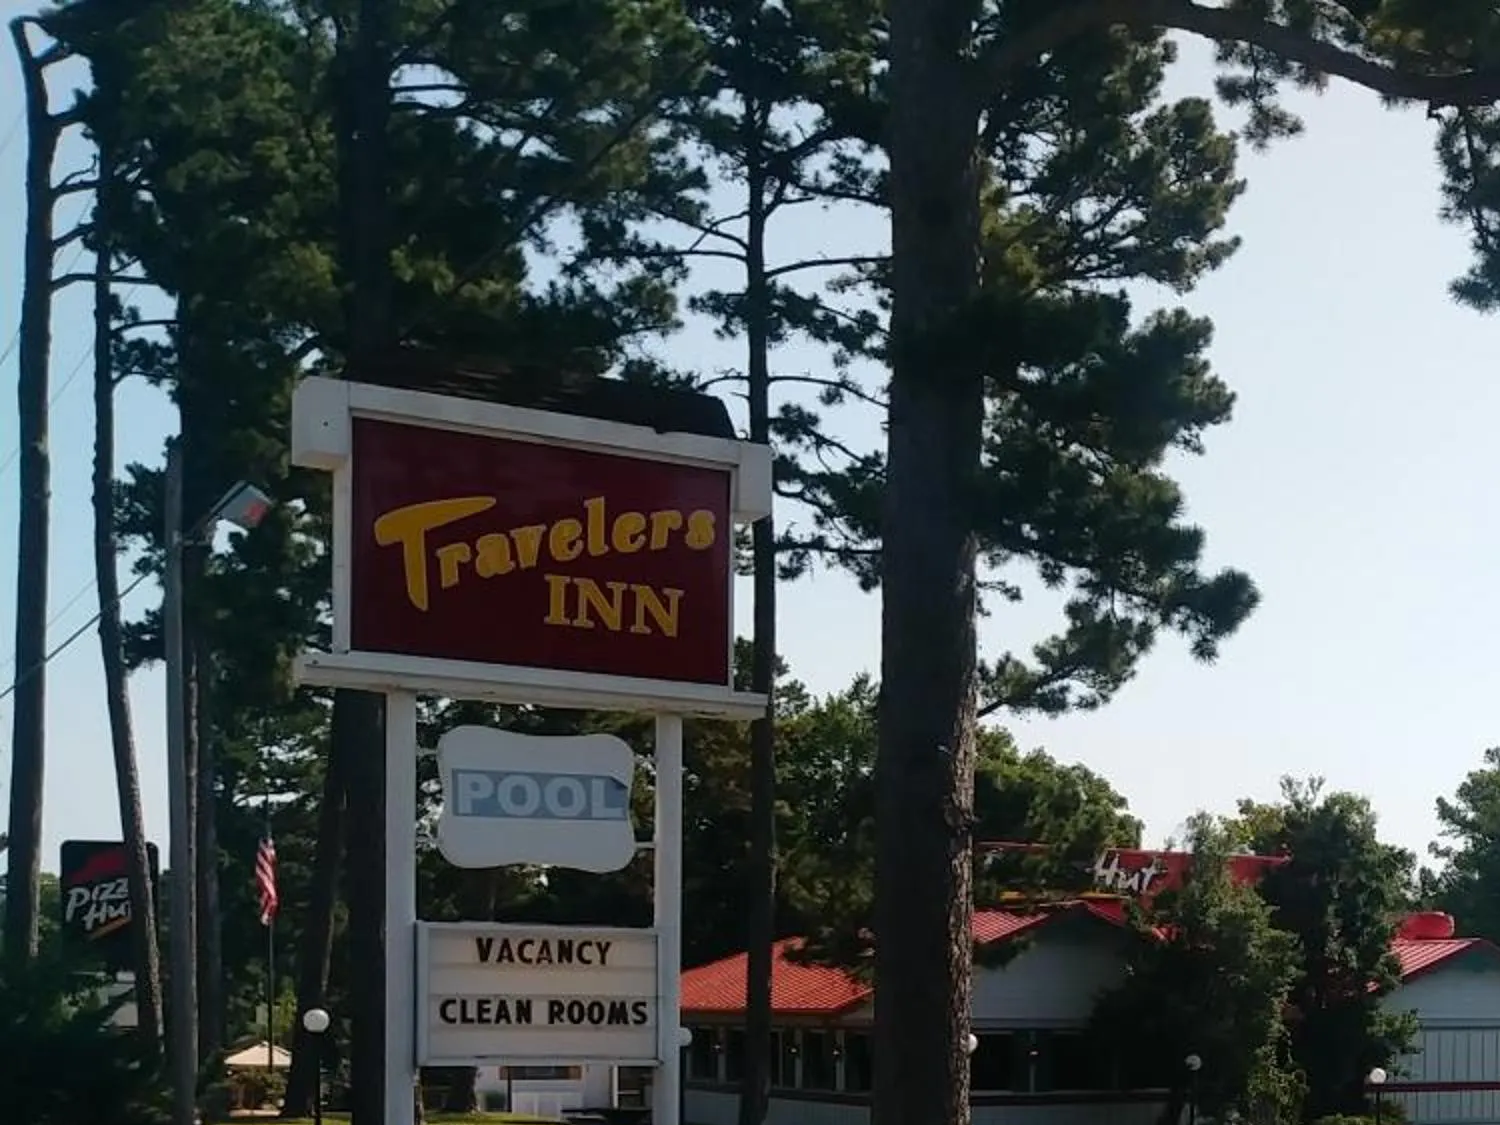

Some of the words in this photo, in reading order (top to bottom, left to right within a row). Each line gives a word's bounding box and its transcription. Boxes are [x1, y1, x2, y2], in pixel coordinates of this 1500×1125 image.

[374, 496, 715, 612] Travelers
[544, 574, 684, 637] INN
[456, 774, 625, 818] POOL
[1087, 848, 1169, 893] Hut
[66, 878, 130, 922] Pizz
[476, 938, 611, 965] VACANCY
[440, 999, 533, 1024] CLEAN
[548, 1001, 648, 1024] ROOMS
